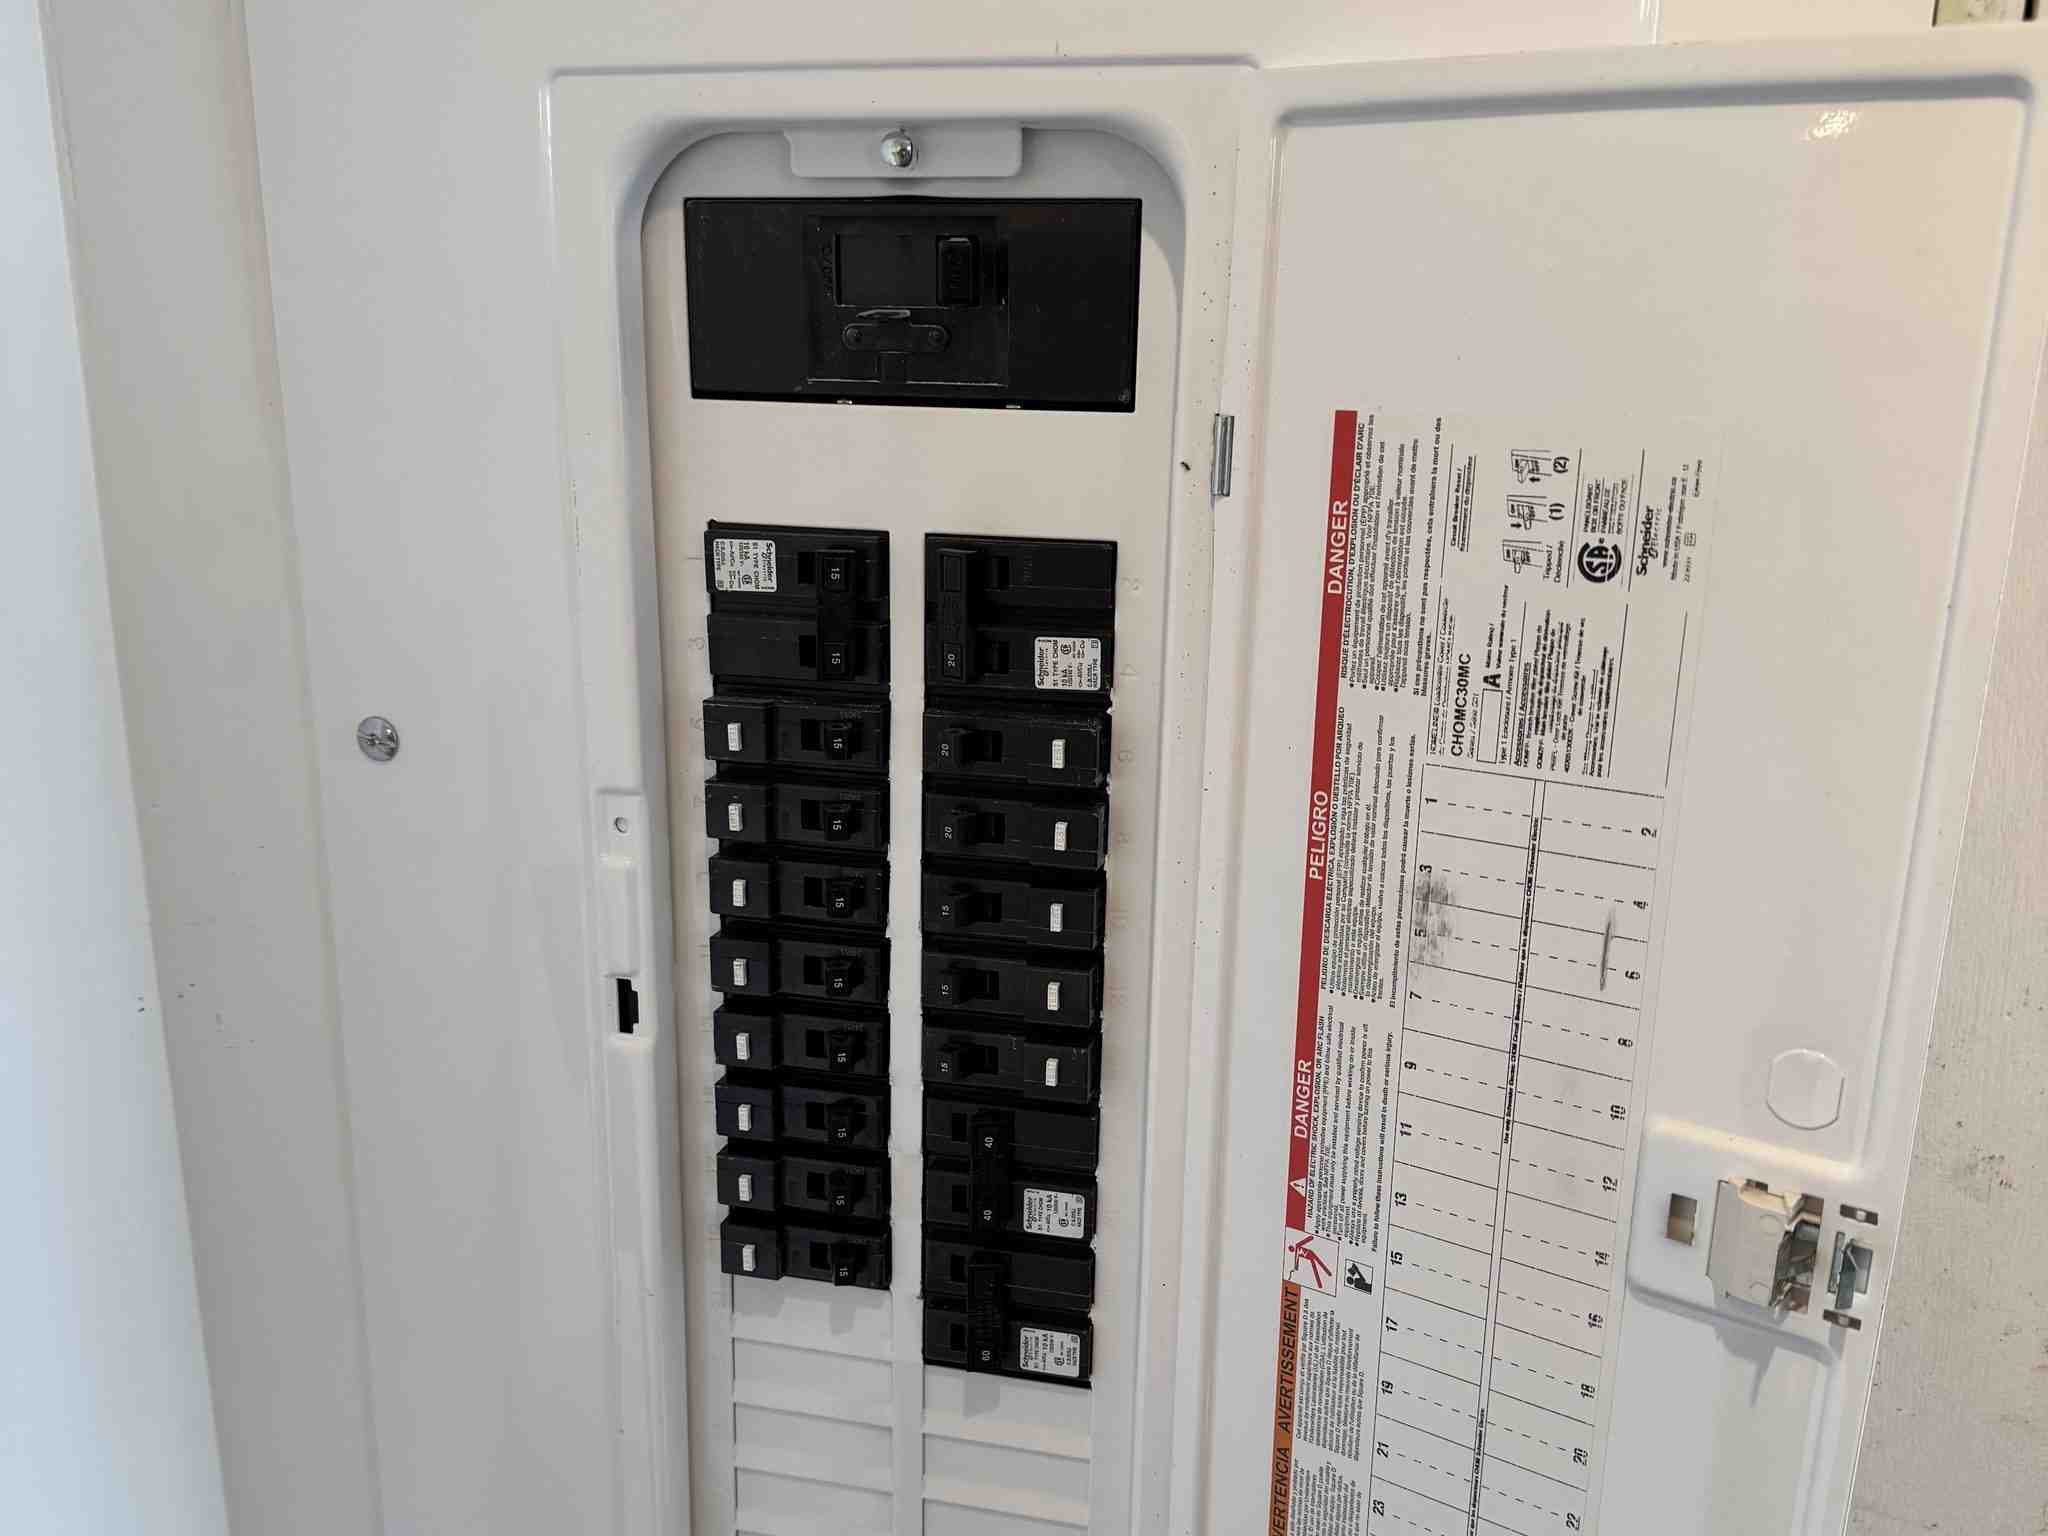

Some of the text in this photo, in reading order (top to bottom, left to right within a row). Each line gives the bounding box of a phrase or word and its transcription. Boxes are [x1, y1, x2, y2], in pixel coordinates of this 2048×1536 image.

[1553, 455, 1569, 473] (2)
[1549, 502, 1565, 520] (1)
[1327, 500, 1348, 594] DANGER
[1635, 505, 1654, 576] Schneider
[765, 543, 773, 583] Schneider
[831, 568, 840, 580] 15
[1340, 647, 1348, 678] RISQUE
[1348, 508, 1358, 564] D'EXPLOSION
[1353, 493, 1359, 506] OU
[832, 653, 840, 664] 15
[948, 654, 955, 667] 20
[1037, 648, 1045, 687] Schneider
[1483, 672, 1500, 687] A
[1450, 652, 1471, 756] CHOMC30MC
[833, 738, 843, 749] 15
[941, 743, 949, 756] 20
[1424, 797, 1437, 805] 1
[833, 820, 842, 830] 15
[945, 826, 952, 839] 20
[1309, 790, 1328, 880] PELIGRO
[1642, 827, 1657, 838] 2
[1419, 864, 1432, 873] 3
[835, 897, 845, 908] 15
[1633, 900, 1648, 910] 4
[942, 905, 949, 916] 15
[1414, 928, 1427, 937] 5
[1625, 969, 1640, 980] 6
[834, 978, 843, 988] 15
[942, 985, 949, 995] 15
[1410, 991, 1423, 1000] 7
[1618, 1037, 1633, 1048] 8
[837, 1053, 846, 1063] 15
[1316, 1058, 1321, 1069] OR
[941, 1062, 948, 1072] 15
[1404, 1061, 1417, 1071] 9
[1313, 1070, 1321, 1112] EXPLOSION,
[1294, 1059, 1311, 1139] DANGER
[1610, 1104, 1626, 1121] 10
[838, 1128, 847, 1138] 15
[1399, 1122, 1412, 1137] 11
[984, 1137, 993, 1149] 40
[1308, 1178, 1314, 1188] OF
[1602, 1176, 1618, 1191] 12
[836, 1195, 845, 1206] 15
[1394, 1193, 1408, 1207] 13
[984, 1210, 992, 1222] 40
[1390, 1251, 1404, 1265] 15
[1595, 1252, 1611, 1266] 14
[839, 1267, 848, 1277] 15
[1386, 1317, 1399, 1332] 17
[1588, 1314, 1603, 1328] 16
[1278, 1287, 1297, 1434] AVERTISSEMENT
[1381, 1380, 1395, 1396] 19
[1580, 1384, 1595, 1398] 18
[1377, 1441, 1391, 1457] 21
[1573, 1448, 1588, 1465] 20
[1372, 1500, 1386, 1516] 23
[1566, 1513, 1581, 1529] 22
